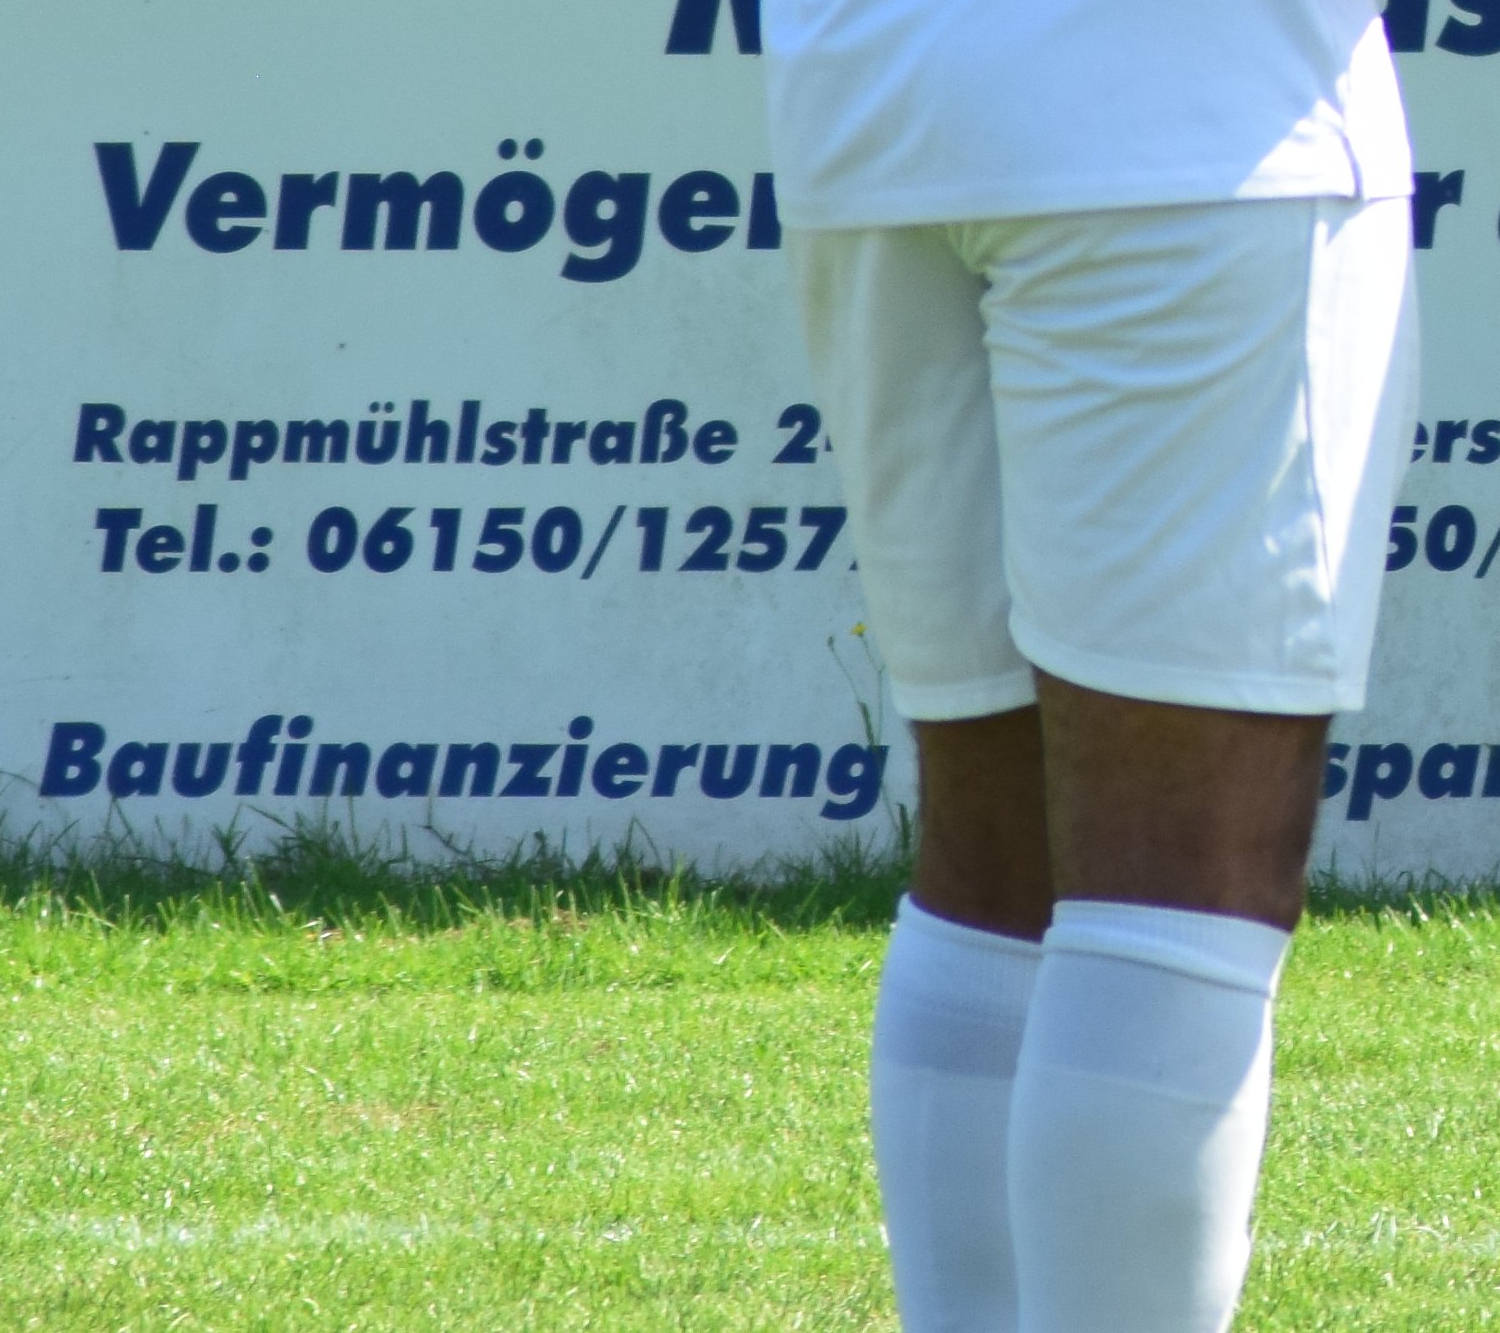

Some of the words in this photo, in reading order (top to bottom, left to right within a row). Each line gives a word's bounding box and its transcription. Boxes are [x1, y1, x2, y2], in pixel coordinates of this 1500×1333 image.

[72, 398, 740, 482] Rappmühlstraße
[771, 402, 834, 465] 2
[95, 503, 274, 575] Tel.:
[305, 505, 858, 581] 06150/1257
[38, 714, 891, 821] Baufinanzierung
